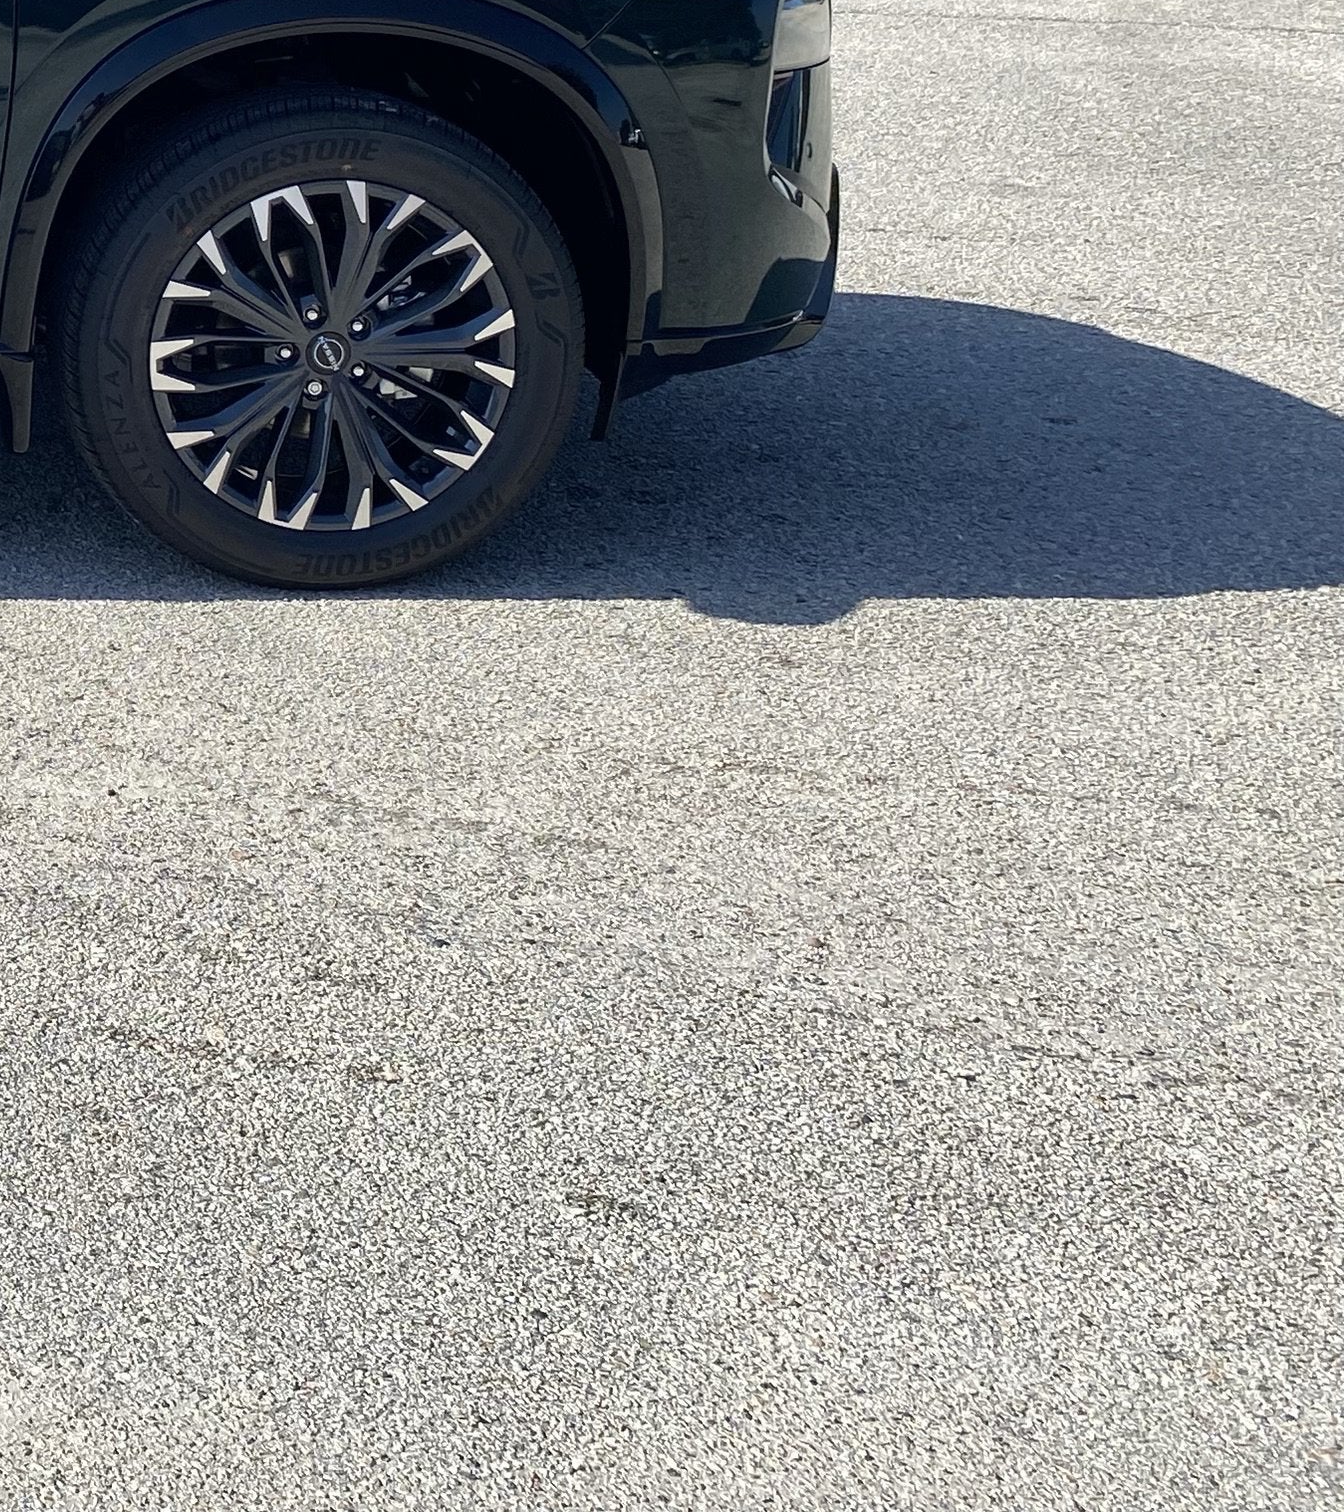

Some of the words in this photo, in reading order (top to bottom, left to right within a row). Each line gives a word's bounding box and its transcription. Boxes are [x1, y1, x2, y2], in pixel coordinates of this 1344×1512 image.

[166, 136, 383, 226] BRIDGESTONE
[104, 370, 162, 489] ALENZA
[291, 486, 505, 578] BRIDGESTONE
